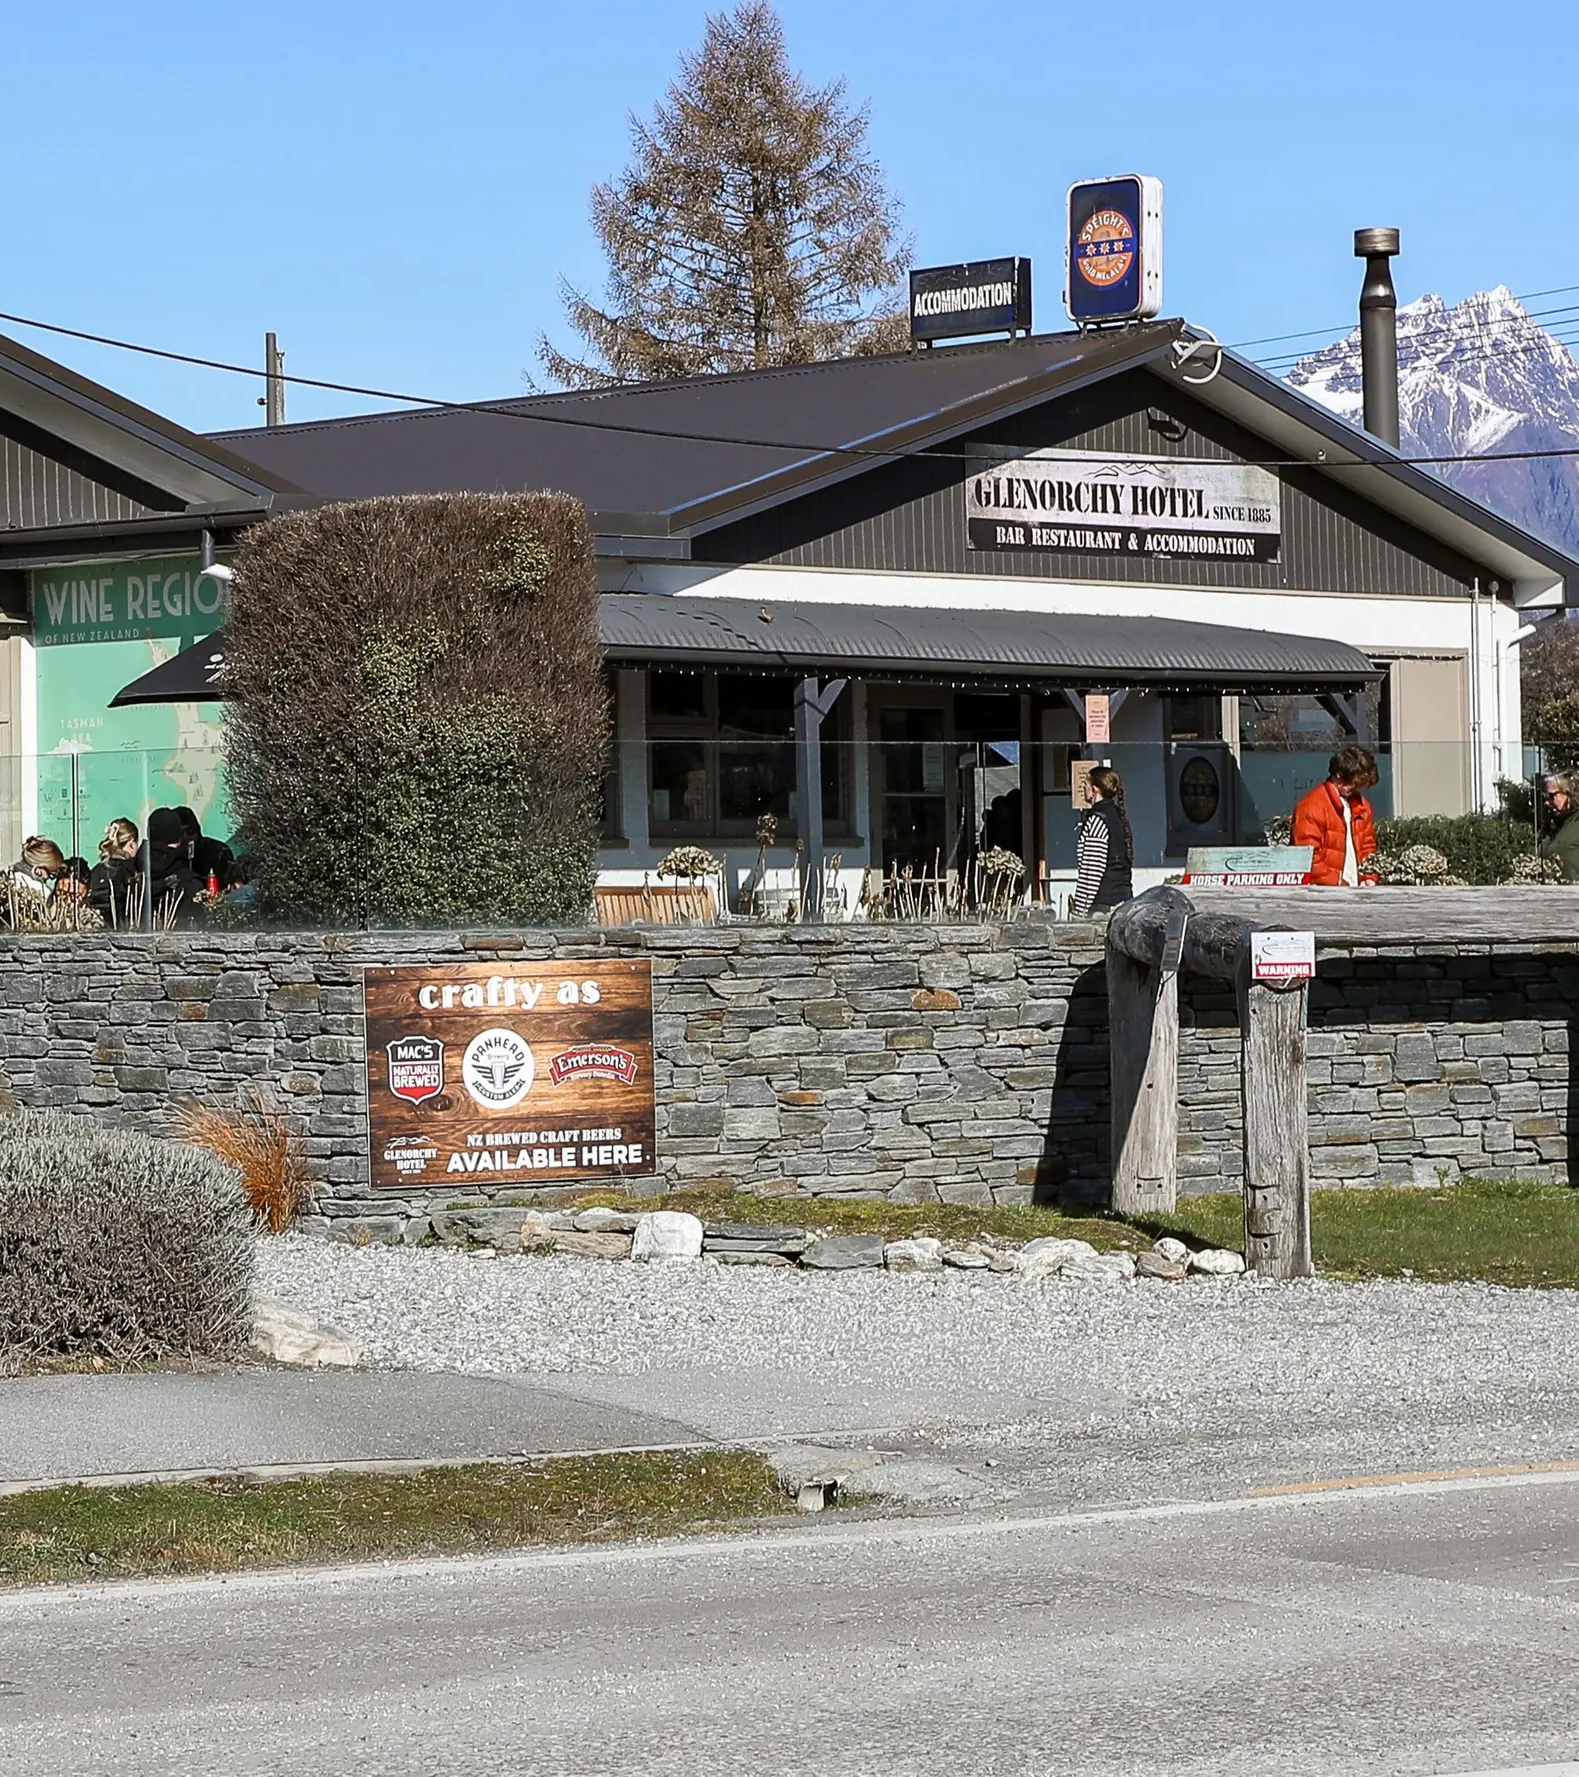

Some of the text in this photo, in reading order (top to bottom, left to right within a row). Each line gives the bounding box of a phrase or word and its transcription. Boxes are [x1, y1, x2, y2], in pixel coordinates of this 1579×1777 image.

[914, 281, 1012, 317] ACCOMMODATION
[974, 477, 1271, 523] GLENORCHY HOTEL SINCE 1885
[996, 526, 1255, 556] BAR RESTAURANT & ACCOMMODATION
[42, 571, 223, 626] WINE REGIO
[45, 628, 140, 644] OF NEW ZEALAND
[60, 716, 103, 729] TASMAN
[1189, 873, 1304, 886] HORSE PARKING ONLY
[1258, 964, 1310, 976] WARNING
[419, 976, 601, 1010] crafty as
[397, 1045, 434, 1060] MAC'S
[471, 1037, 525, 1062] PANHEAD
[393, 1064, 439, 1075] NATURALLY
[557, 1053, 627, 1073] Emerson's
[394, 1074, 439, 1088] BREWED
[467, 1128, 622, 1147] NZ BREWED CRAFT BEERS
[383, 1148, 438, 1160] GLENORCHY
[446, 1144, 643, 1173] AVAILABLE HERE
[396, 1159, 427, 1170] HOTEL
